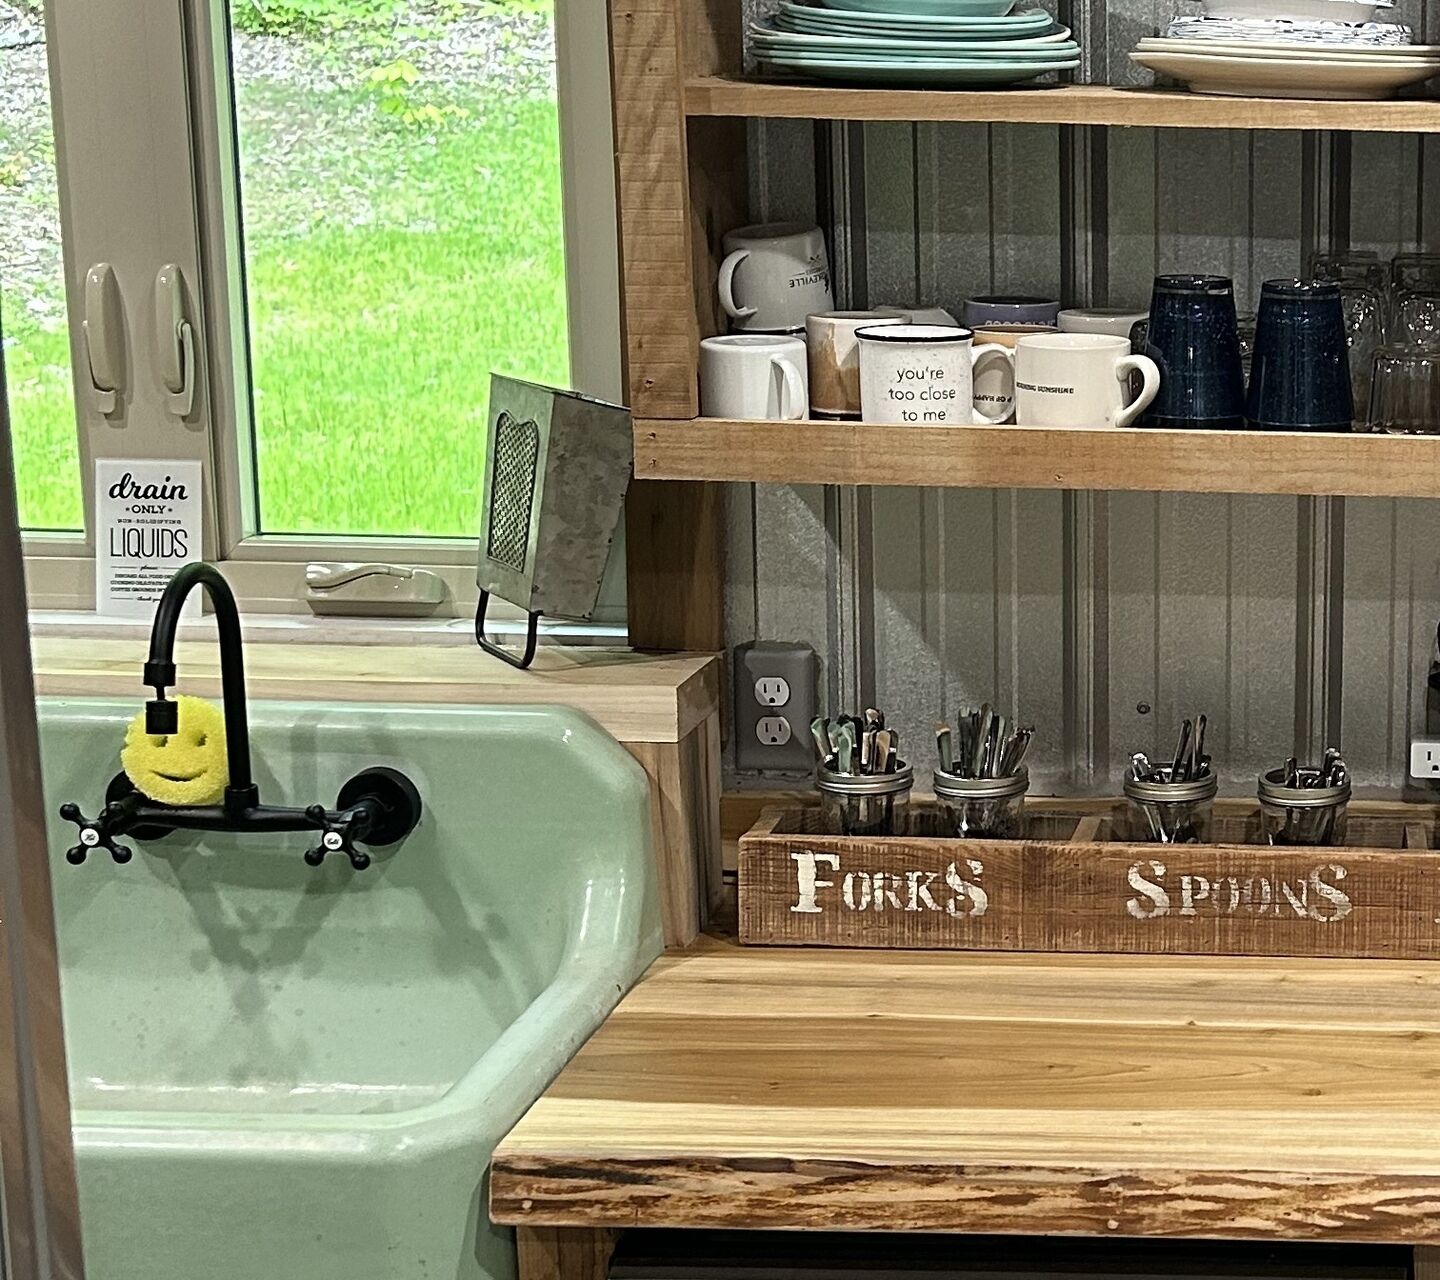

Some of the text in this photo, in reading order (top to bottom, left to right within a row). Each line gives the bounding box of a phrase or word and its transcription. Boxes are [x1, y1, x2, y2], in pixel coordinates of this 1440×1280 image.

[896, 366, 945, 383] you're
[888, 385, 956, 401] too close
[902, 410, 946, 421] to me
[109, 472, 188, 500] drain
[131, 504, 167, 514] ONLY
[110, 528, 188, 558] LIQUIDS
[790, 850, 989, 919] FORKS
[1126, 859, 1353, 923] SPOONS
